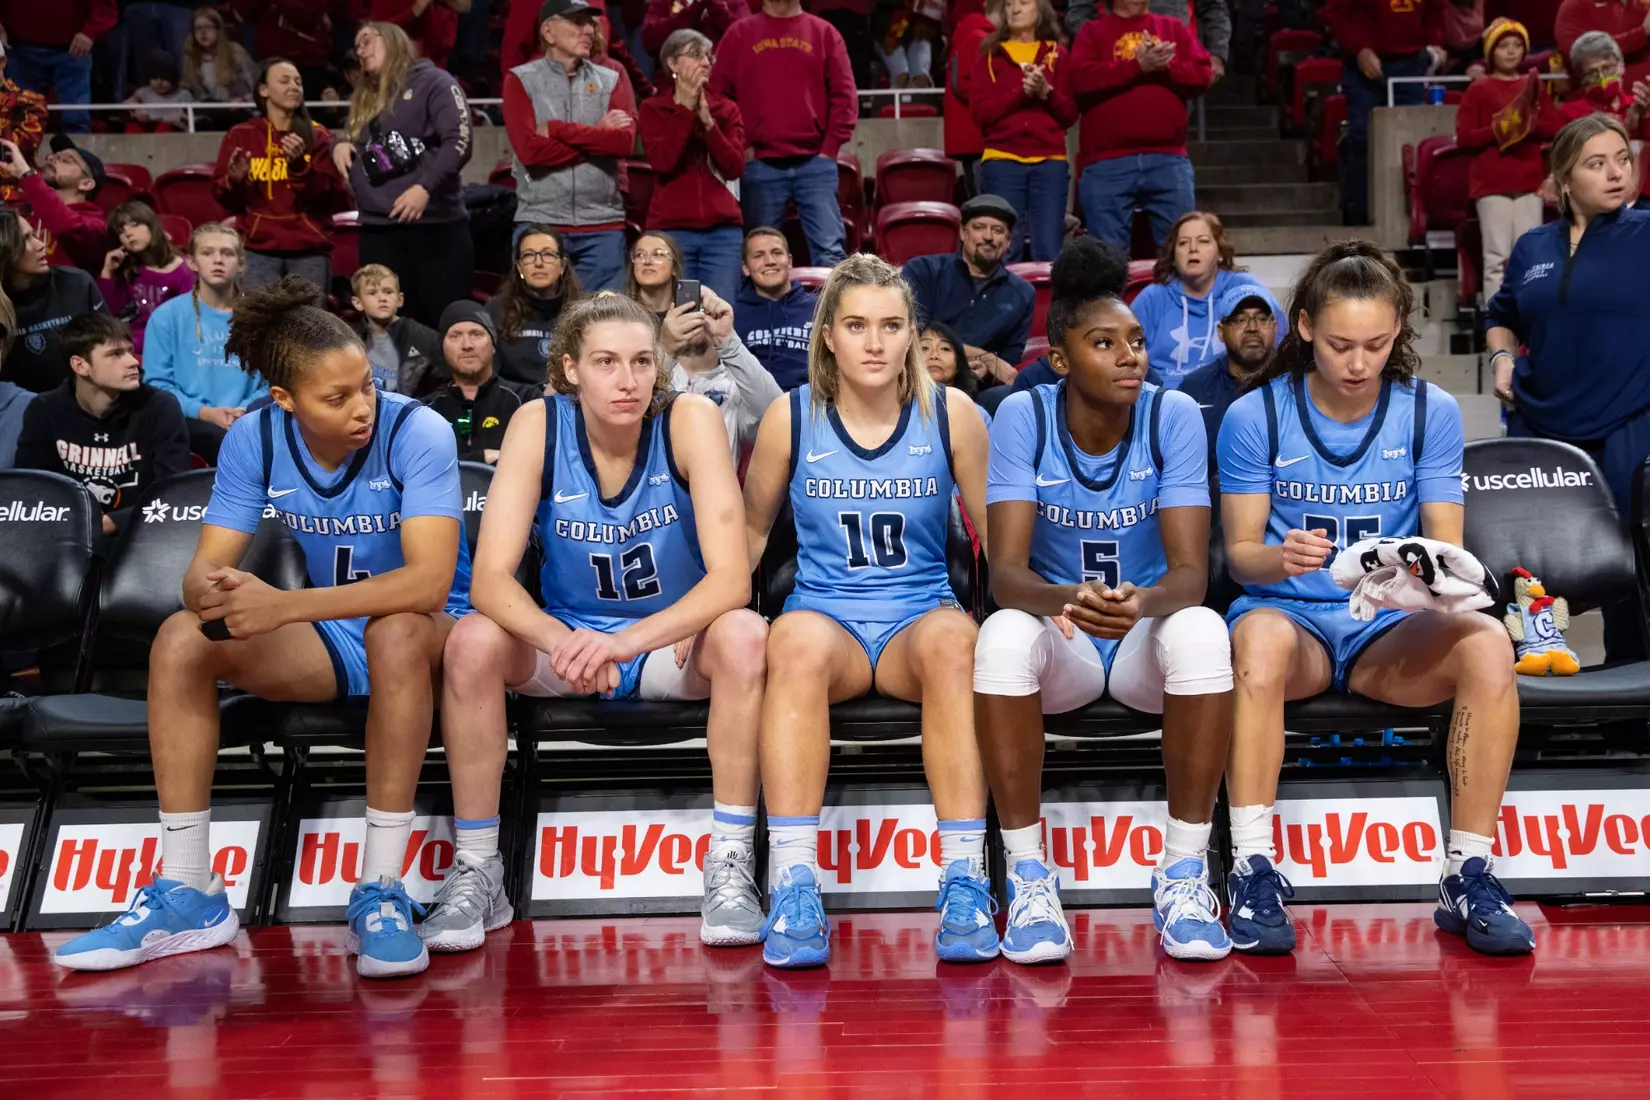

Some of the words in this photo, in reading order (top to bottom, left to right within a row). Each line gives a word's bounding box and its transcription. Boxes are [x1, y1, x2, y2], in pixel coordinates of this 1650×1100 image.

[752, 38, 779, 54] IOWA
[779, 37, 813, 54] STATE
[805, 477, 938, 499] COLUMBIA
[1275, 480, 1408, 505] COLUMBIA
[1473, 466, 1591, 491] uscellular
[554, 504, 681, 545] COLUMBIA
[838, 510, 909, 571] 10
[588, 541, 663, 602] 12
[1079, 538, 1122, 591] 5
[1533, 610, 1556, 640] C
